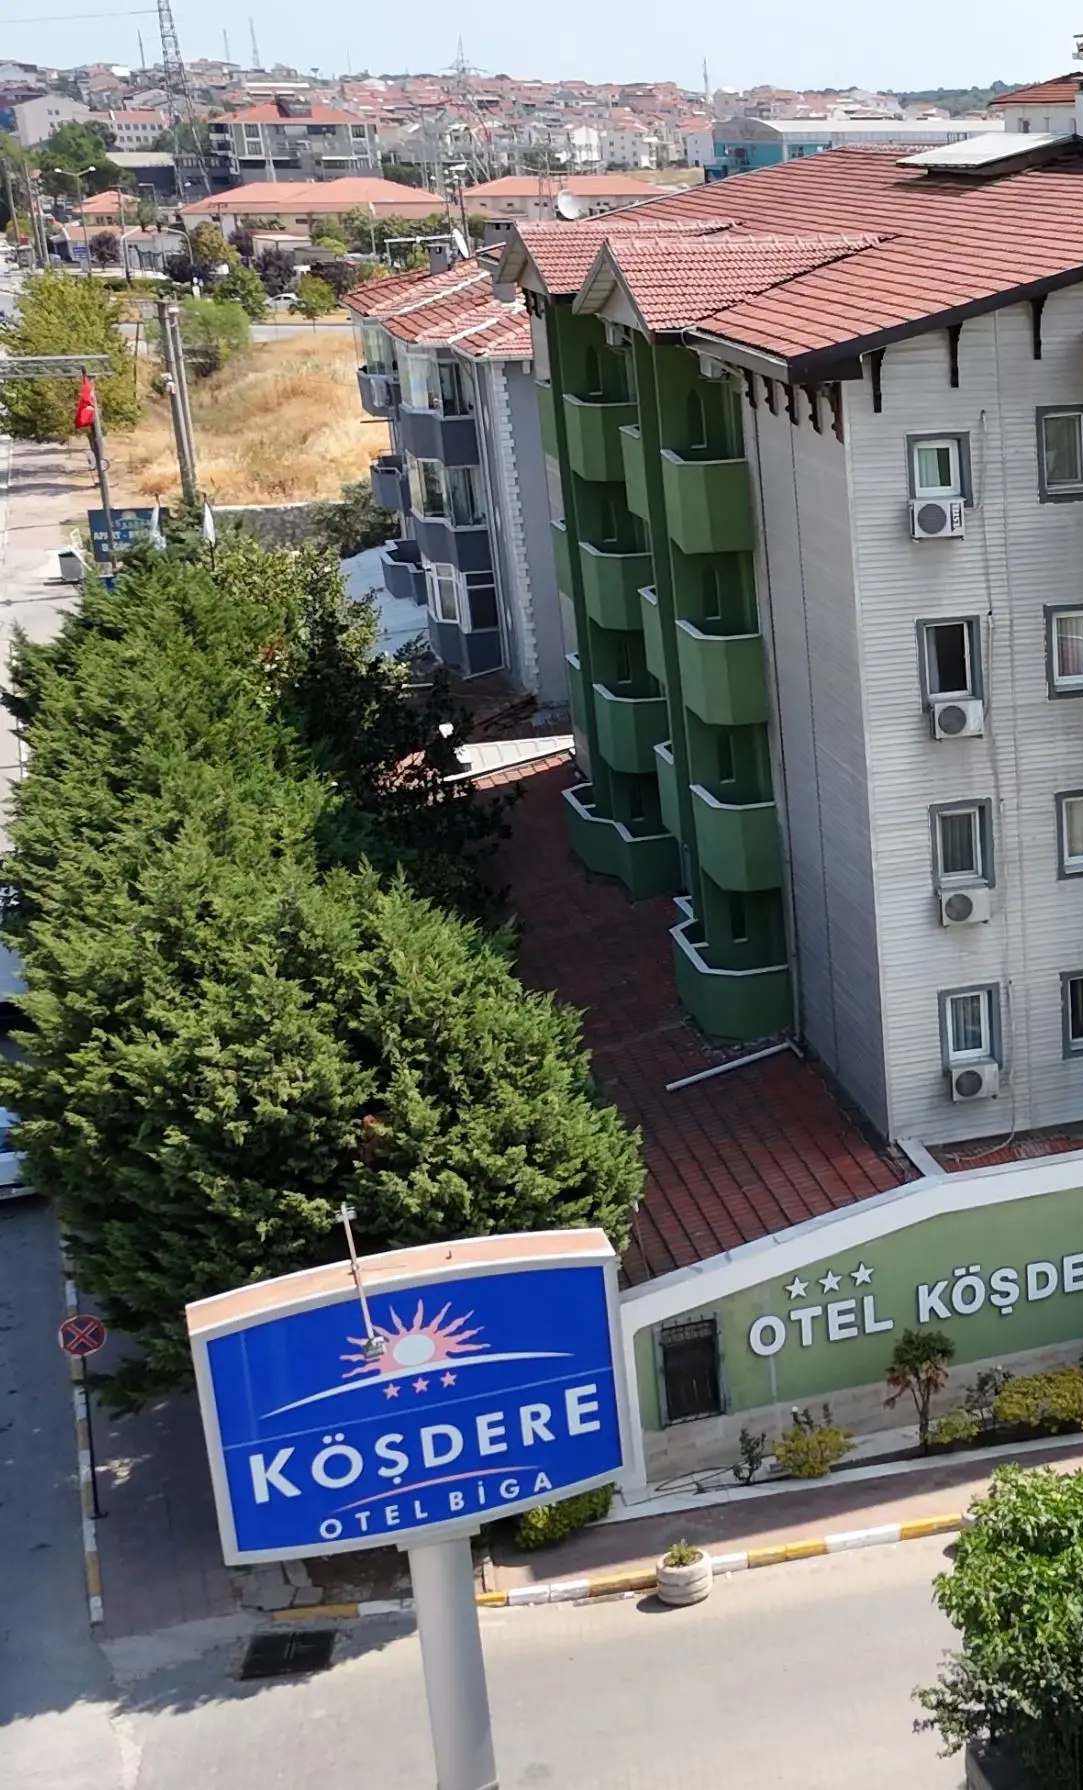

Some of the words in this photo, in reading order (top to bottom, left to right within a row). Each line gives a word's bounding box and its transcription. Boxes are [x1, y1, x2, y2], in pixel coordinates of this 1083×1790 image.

[749, 1295, 894, 1356] OTEL
[249, 1383, 601, 1504] KÖŞDERE
[319, 1501, 430, 1539] OTEL
[449, 1471, 553, 1513] BİGA
